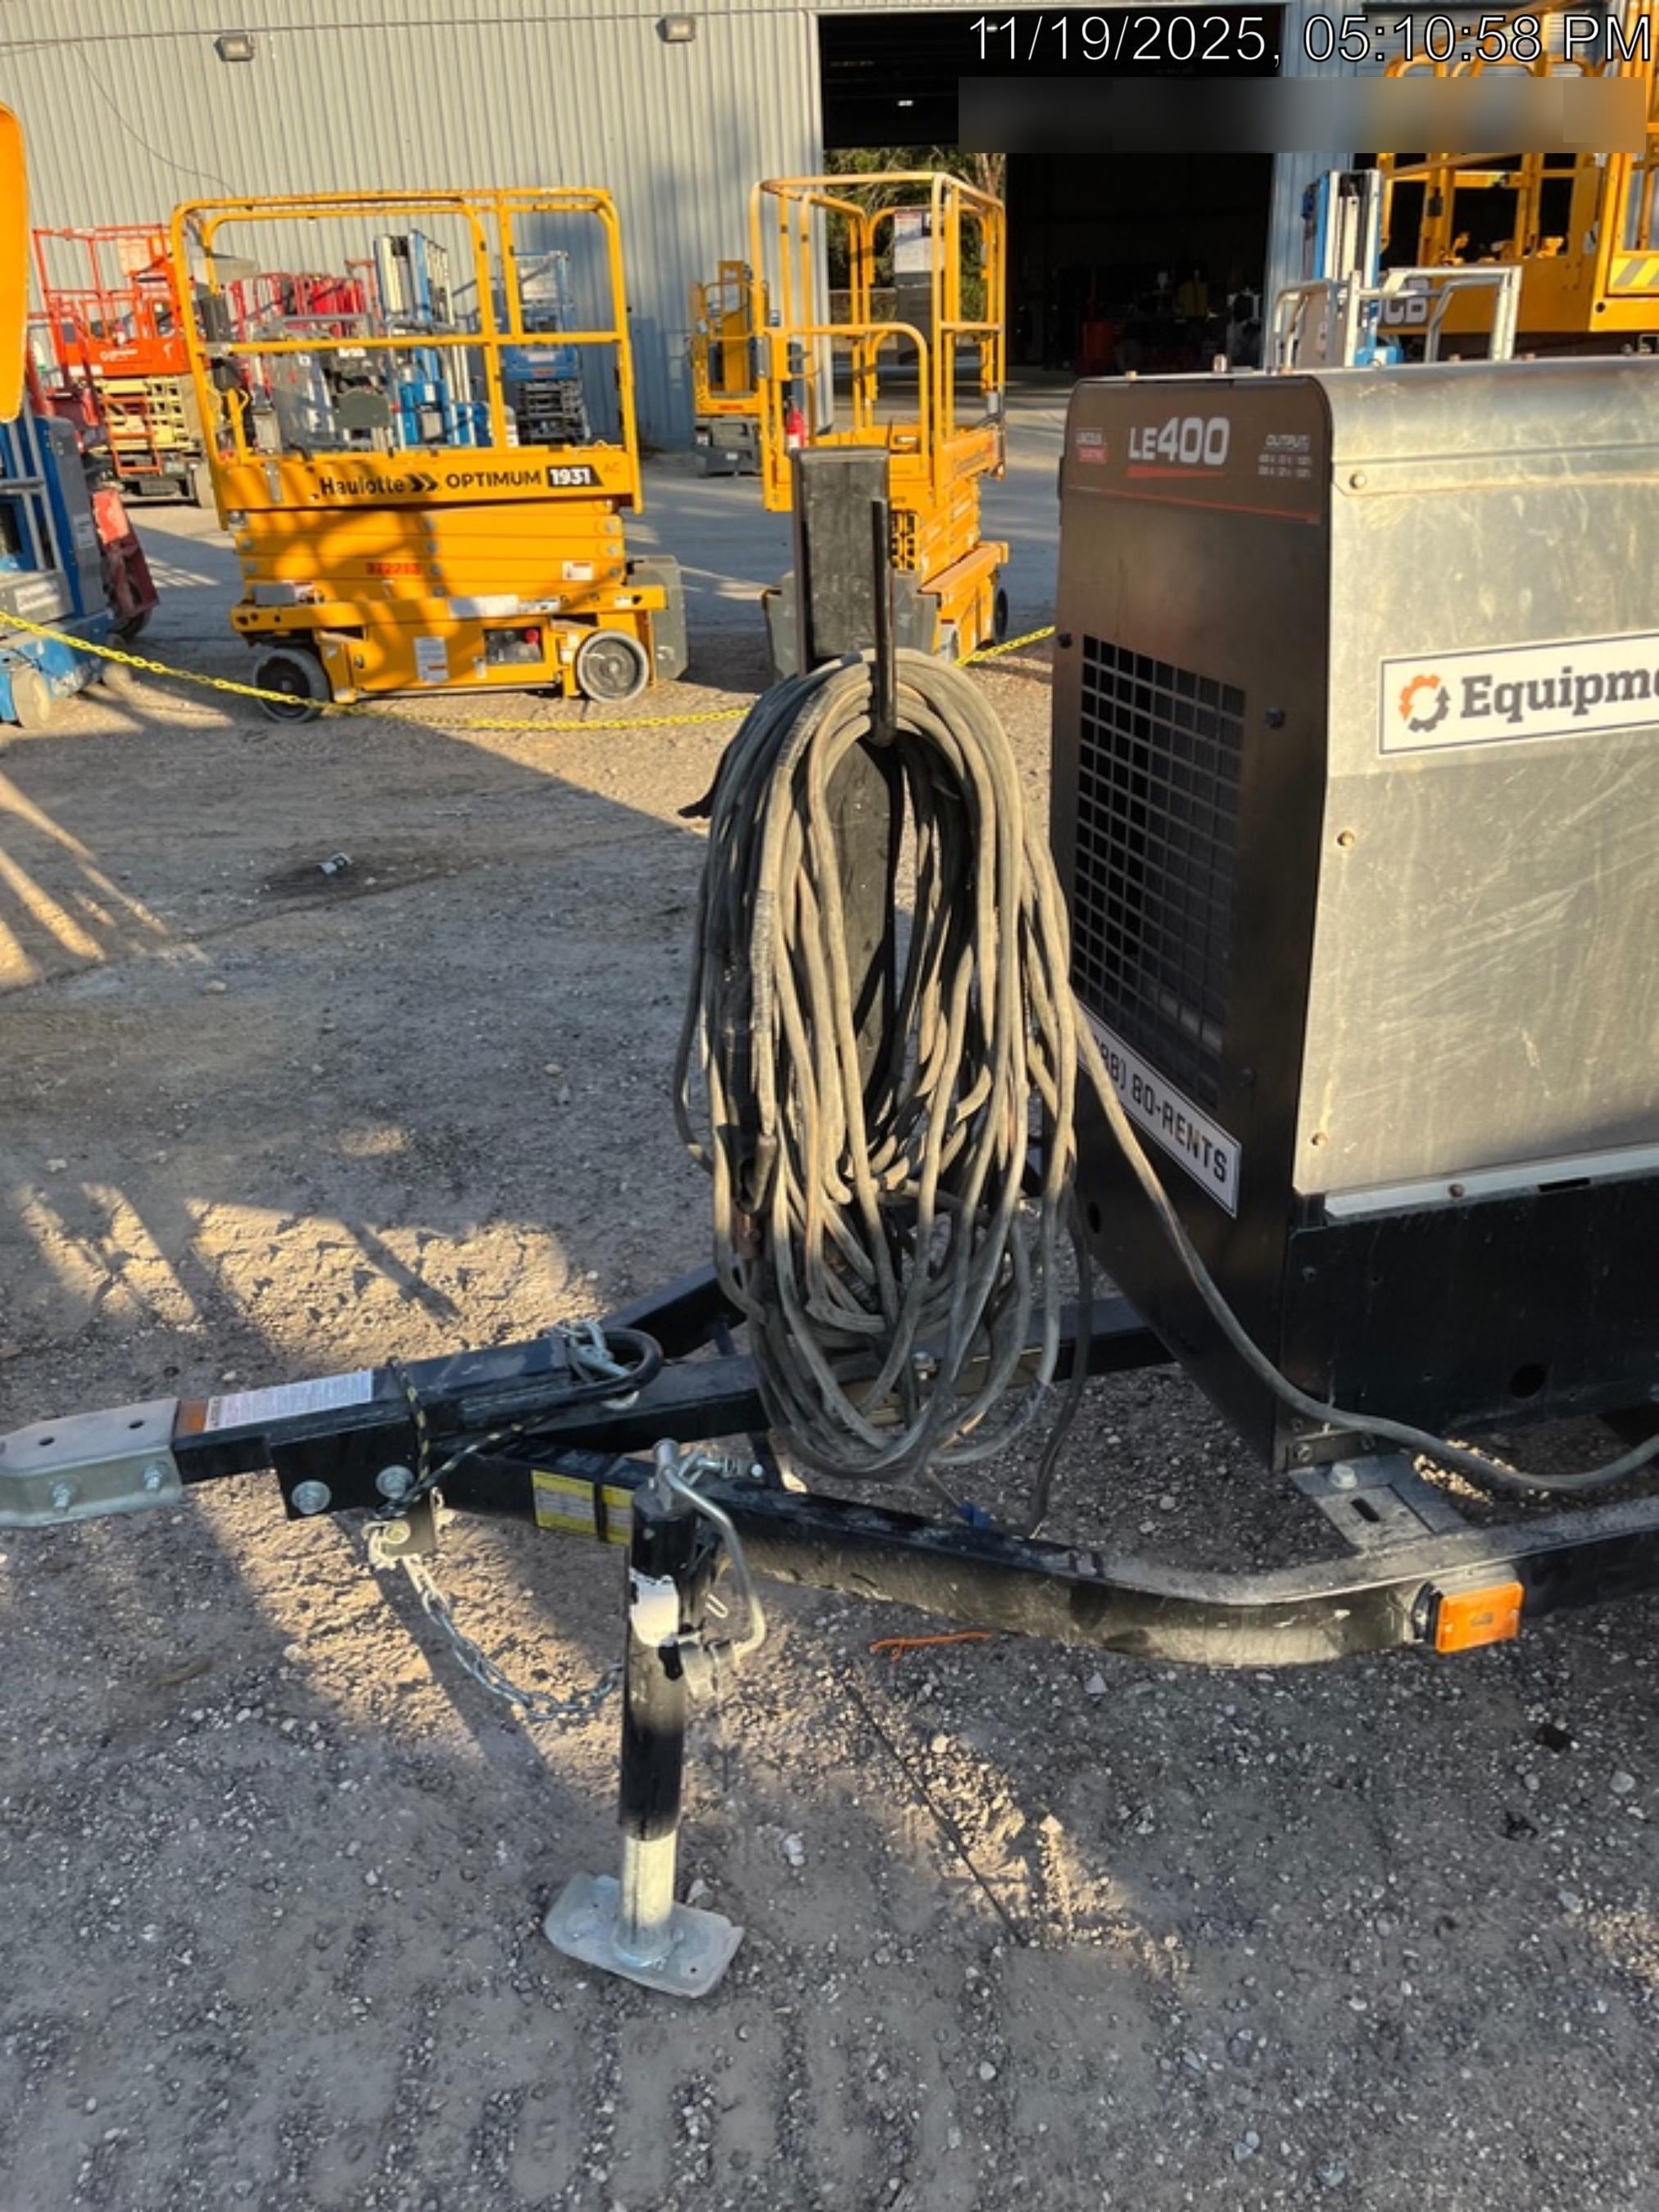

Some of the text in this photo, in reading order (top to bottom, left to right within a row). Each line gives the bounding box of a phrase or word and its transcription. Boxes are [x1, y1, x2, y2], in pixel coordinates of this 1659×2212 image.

[1128, 416, 1230, 465] LE400
[320, 477, 405, 496] Haulotte
[446, 470, 541, 489] OPTIMUM
[550, 466, 592, 486] 1931
